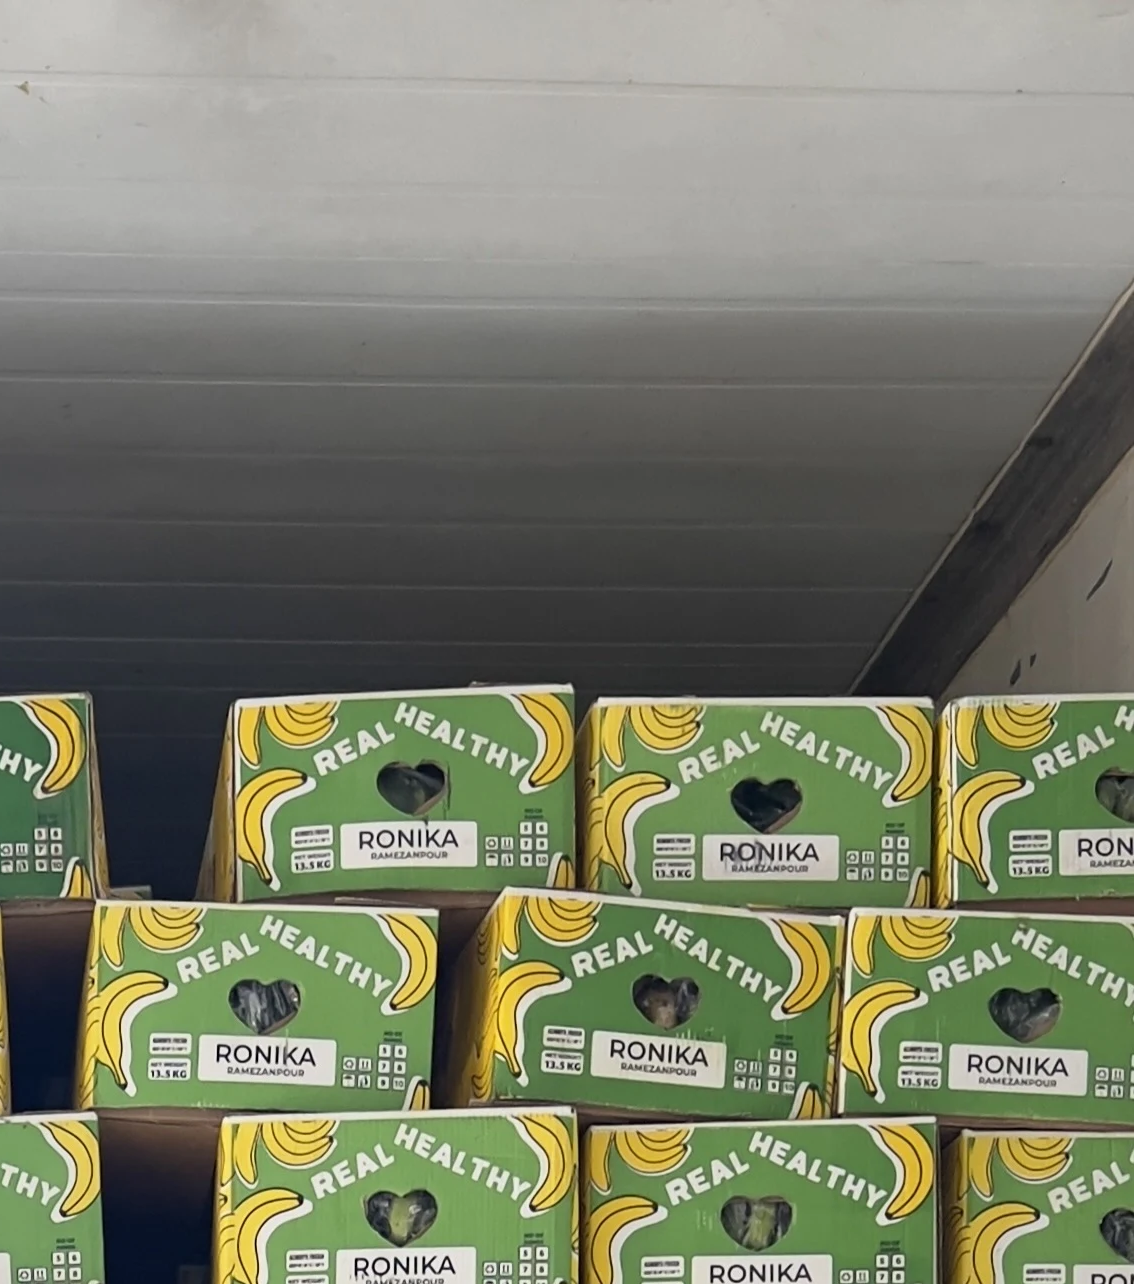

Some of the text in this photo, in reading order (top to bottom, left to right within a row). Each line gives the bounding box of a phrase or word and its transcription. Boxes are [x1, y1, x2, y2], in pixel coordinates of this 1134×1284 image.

[312, 701, 530, 778] REAL HEALTHY
[677, 710, 894, 792] REAL HEALTHY
[1030, 725, 1116, 780] REAL
[358, 828, 459, 853] RONIKA
[370, 850, 449, 863] RAMEZANPOUR
[719, 841, 820, 863] RONIKA
[176, 913, 393, 999] REAL HEALTHY
[570, 913, 783, 1004] REAL HEALTHY
[927, 942, 1012, 992] REAL
[216, 1043, 316, 1068] RONIKA
[227, 1066, 305, 1079] RAMEZANPOUR
[609, 1038, 708, 1068] RONIKA
[967, 1052, 1068, 1078] RONIKA
[978, 1076, 1057, 1089] RAMEZANPOUR
[310, 1123, 532, 1202] REAL HEALTHY
[664, 1130, 888, 1210] REAL HEALTHY
[1046, 1161, 1131, 1214] REAL
[353, 1254, 456, 1279] RONIKA
